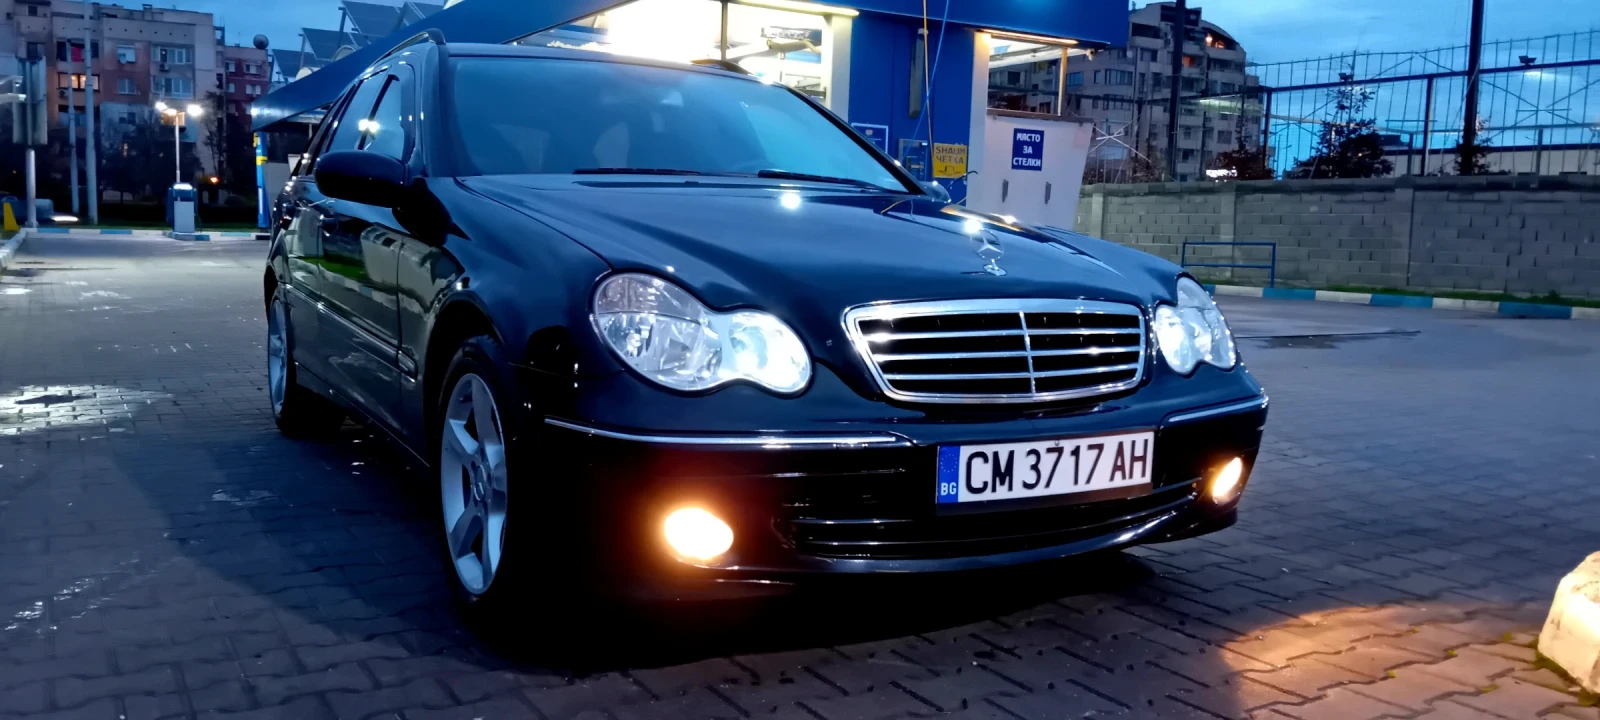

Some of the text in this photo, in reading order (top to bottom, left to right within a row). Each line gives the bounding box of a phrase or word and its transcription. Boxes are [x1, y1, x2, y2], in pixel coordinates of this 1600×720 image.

[1016, 132, 1041, 143] МЯСТО
[1022, 145, 1033, 154] ЗА
[1013, 157, 1041, 167] СТЕЛКИ
[965, 438, 1149, 494] CM 3717 AH
[940, 482, 957, 496] BG
